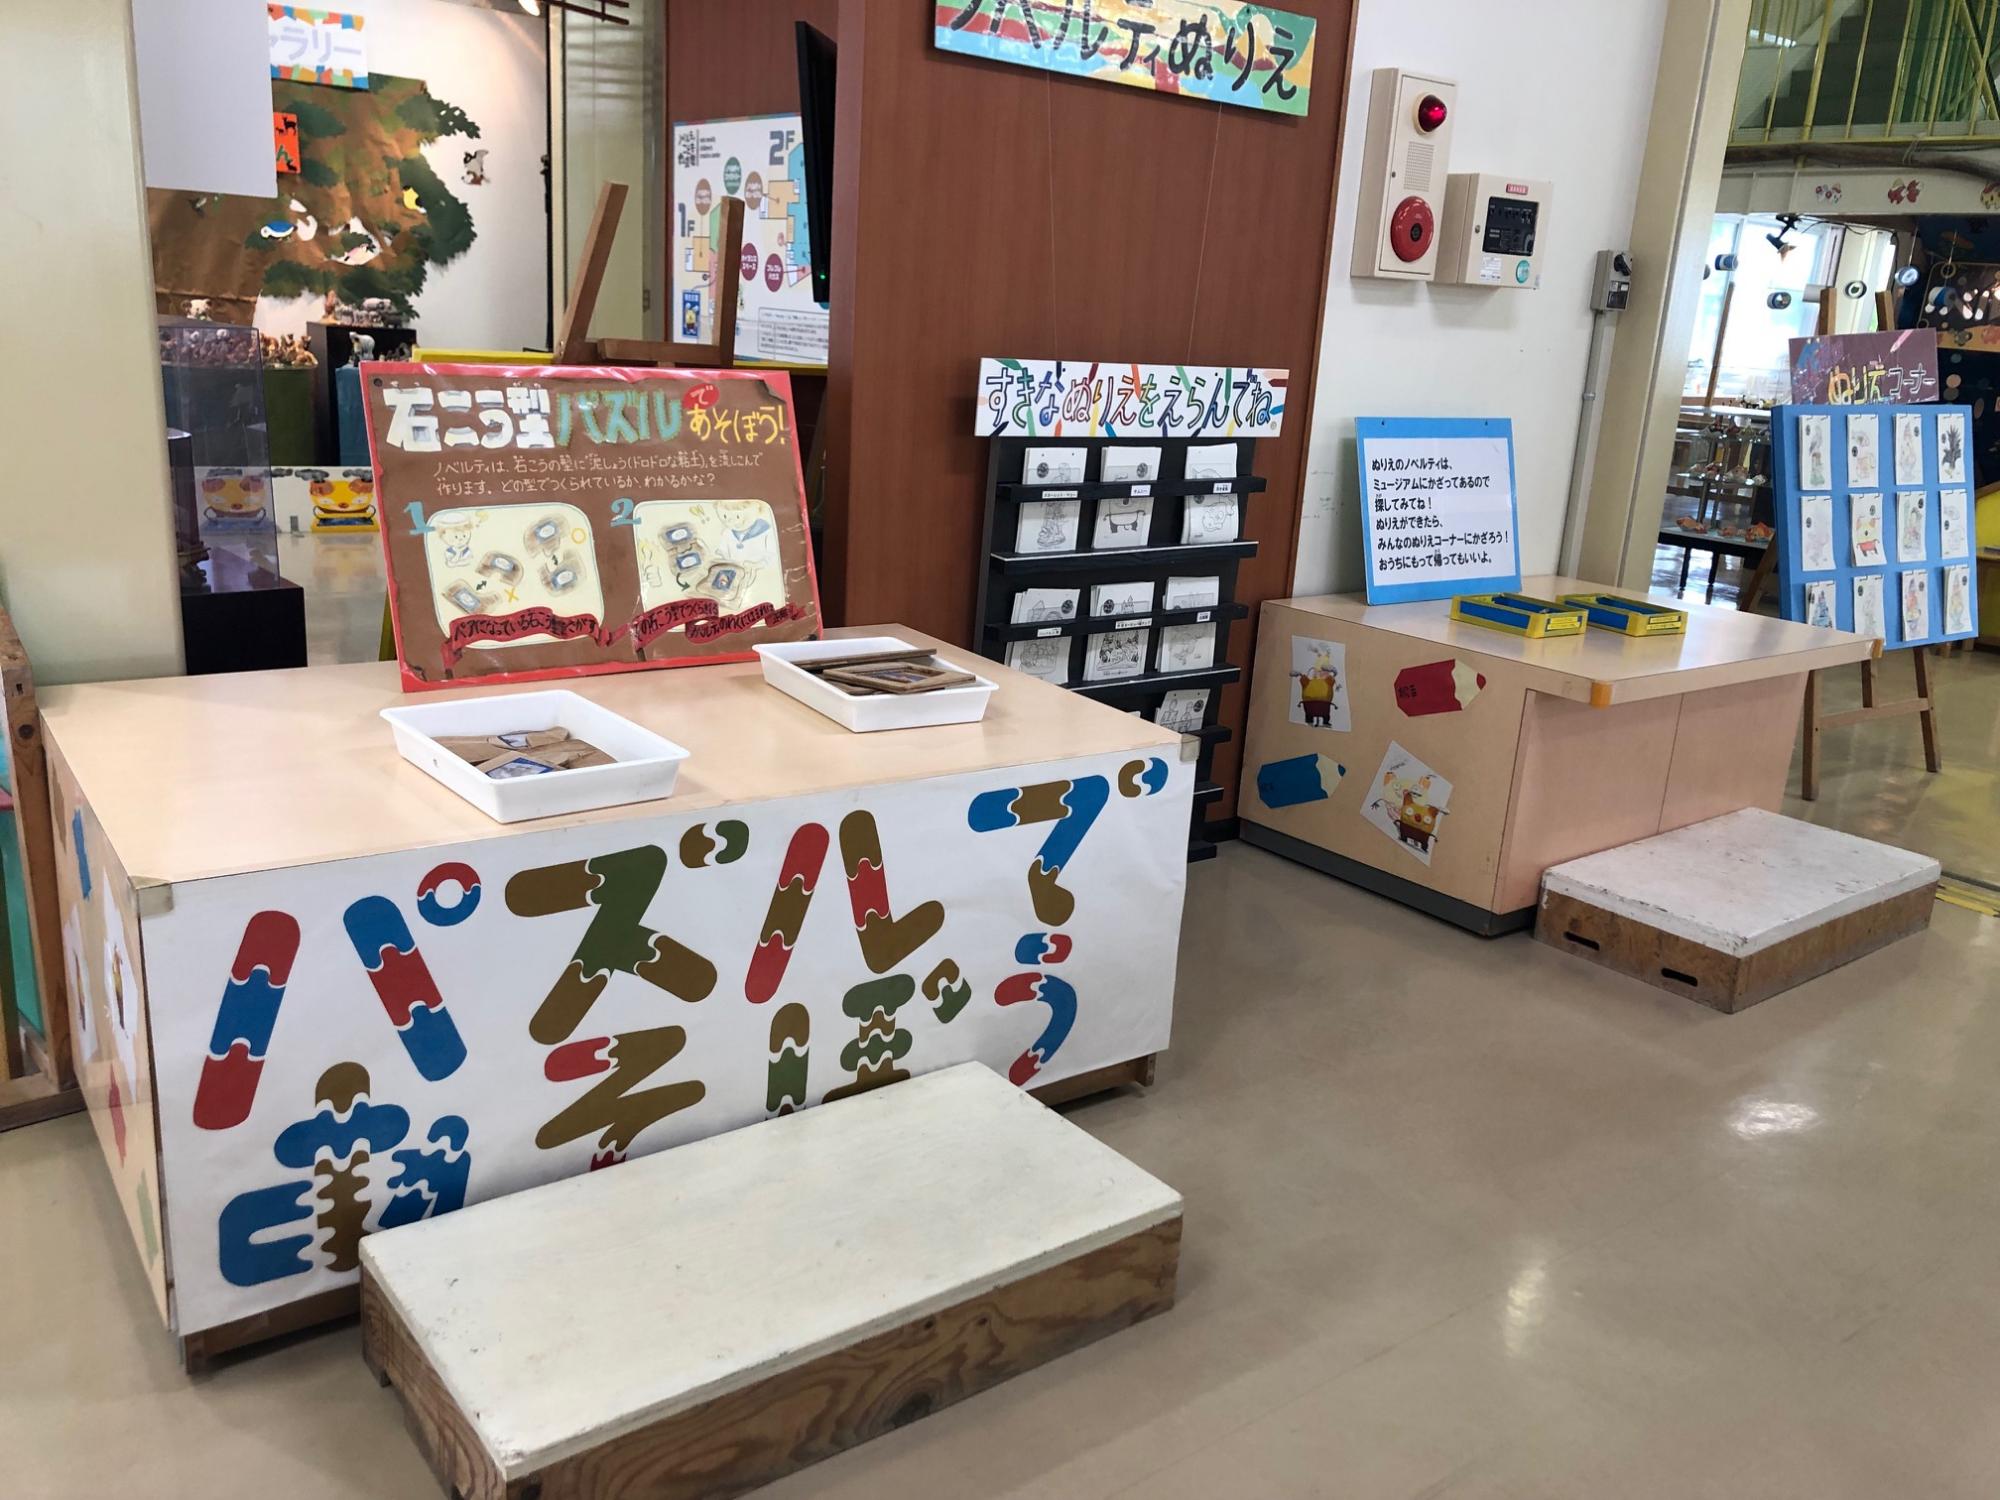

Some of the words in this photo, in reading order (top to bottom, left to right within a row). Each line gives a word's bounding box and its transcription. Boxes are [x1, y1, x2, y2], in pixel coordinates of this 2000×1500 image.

[769, 130, 795, 166] 2F
[678, 203, 695, 238] 1F
[689, 384, 714, 402] で
[687, 404, 788, 446] あそぼう！
[1372, 457, 1453, 471] ぬりえのノベルティは、
[1373, 475, 1491, 491] ミュージアムにかざってあるので
[610, 497, 642, 527] 2
[1375, 497, 1432, 512] 探してみてね！
[404, 500, 435, 535] 1
[1376, 515, 1443, 530] ぬりえができたら、
[1378, 531, 1509, 550] みんなのぬりえコーナーにかざろう！
[1379, 551, 1492, 571] おうちにもって帰ってもいいよ。
